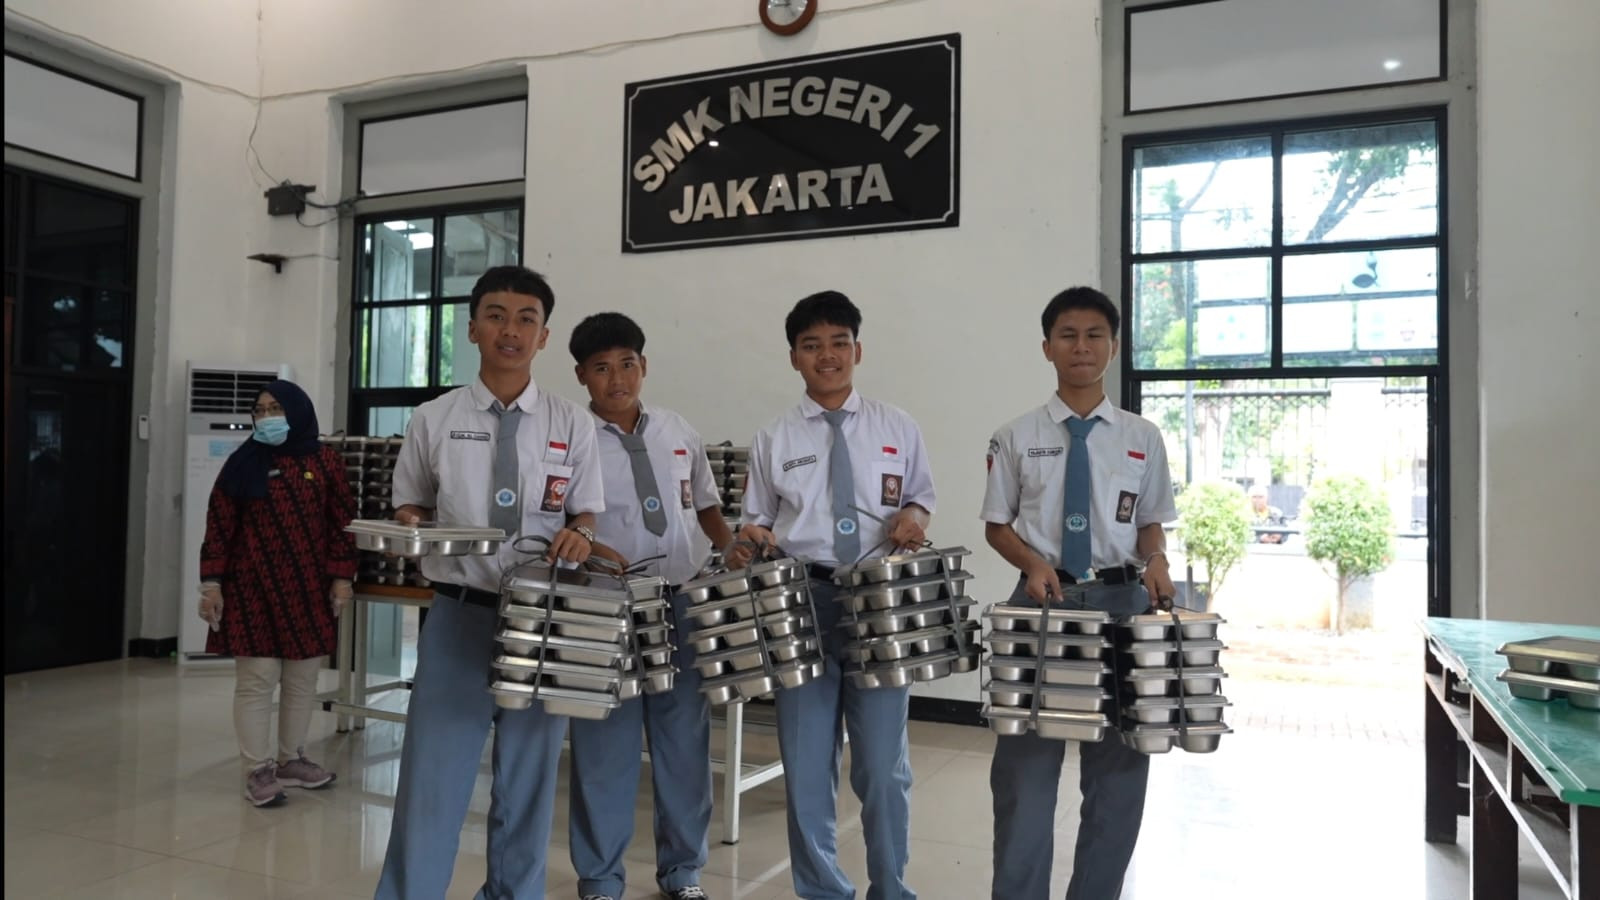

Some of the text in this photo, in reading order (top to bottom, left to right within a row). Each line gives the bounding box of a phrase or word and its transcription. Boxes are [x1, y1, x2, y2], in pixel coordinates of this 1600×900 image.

[633, 77, 940, 192] SMK NEGERI 1
[669, 163, 893, 224] JAKARTA
